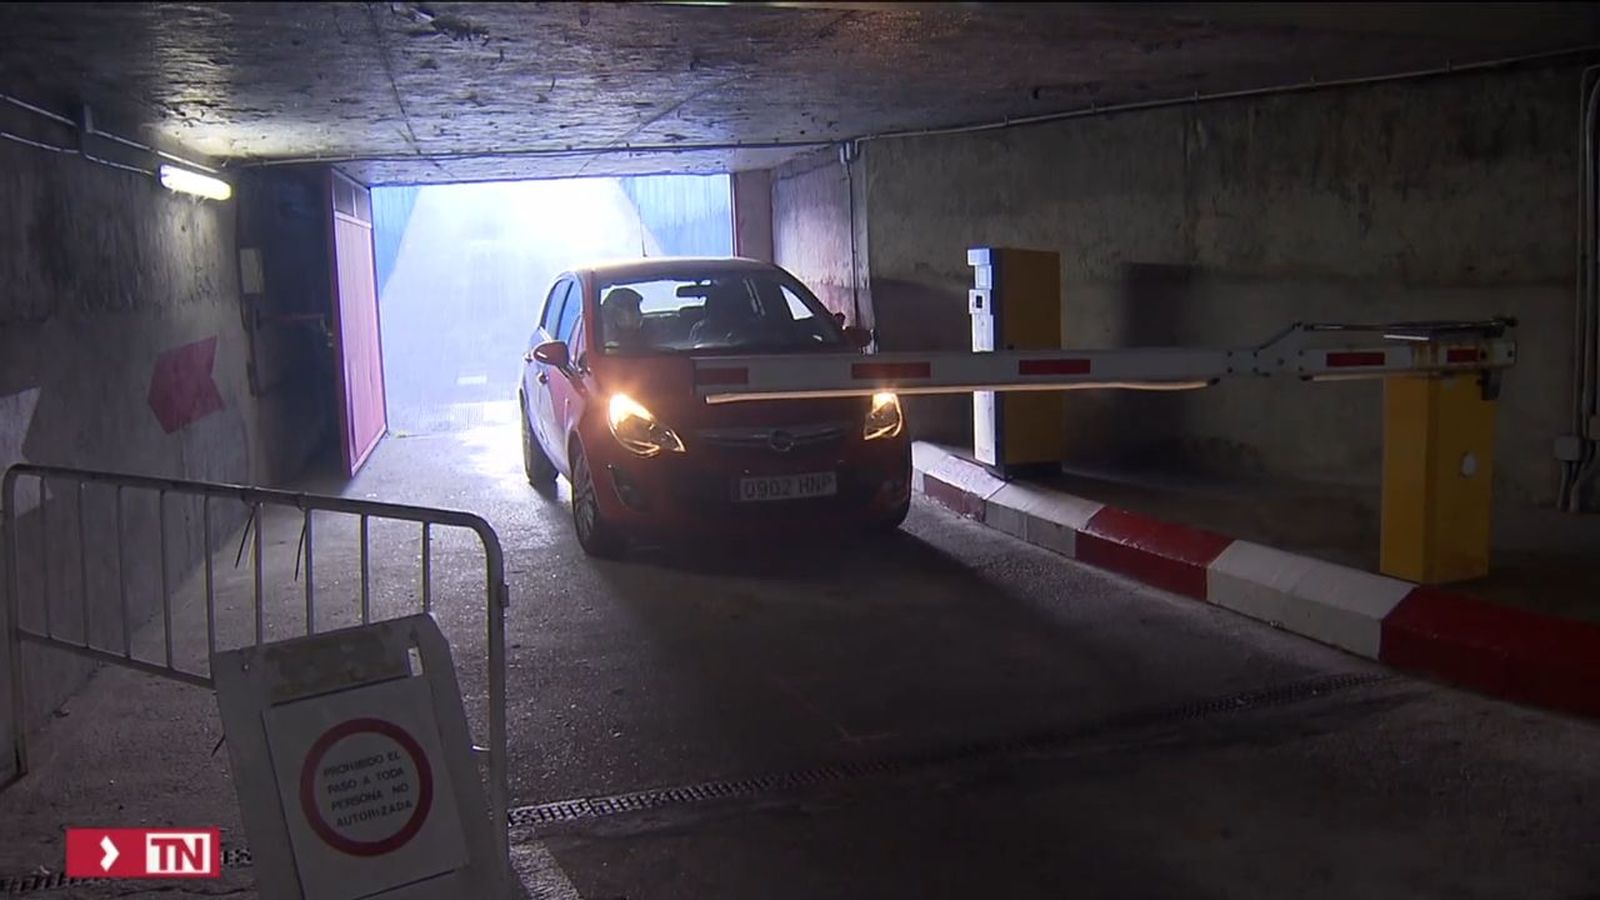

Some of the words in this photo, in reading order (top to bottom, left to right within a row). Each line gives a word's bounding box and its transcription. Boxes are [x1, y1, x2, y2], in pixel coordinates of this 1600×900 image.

[744, 479, 793, 499] 0902
[799, 474, 833, 494] HNP
[323, 754, 384, 775] PROHIBIDO
[388, 750, 401, 761] EL
[327, 779, 357, 794] PASO
[363, 776, 371, 785] A
[376, 767, 405, 781] TODA
[331, 790, 384, 811] PERSONA
[392, 783, 409, 793] NO
[337, 800, 413, 827] AUTORIZADA
